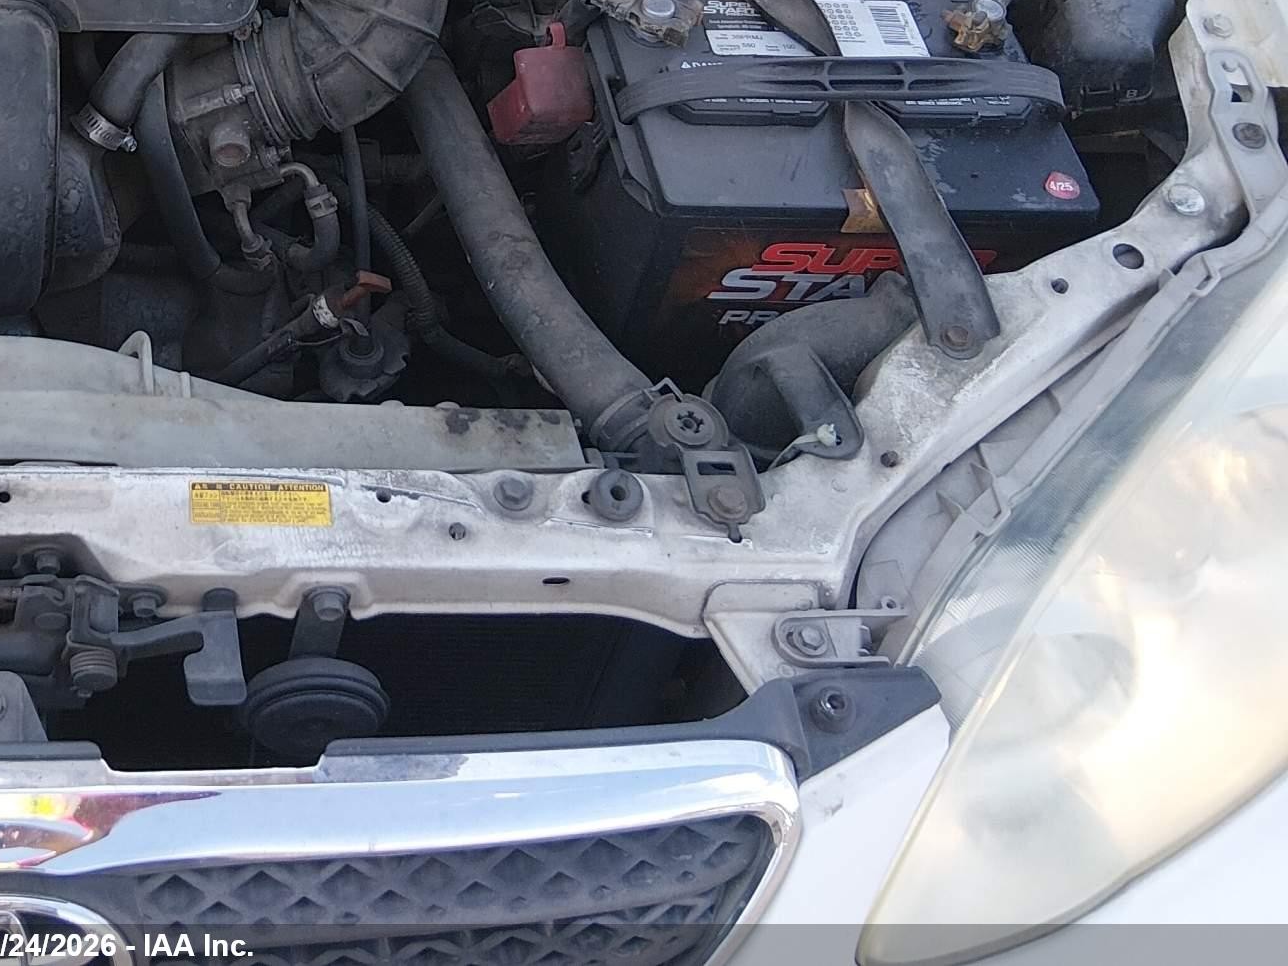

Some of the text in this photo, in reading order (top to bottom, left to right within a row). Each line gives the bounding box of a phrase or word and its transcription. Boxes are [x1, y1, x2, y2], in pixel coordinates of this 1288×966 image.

[752, 242, 997, 275] SUP
[706, 267, 870, 301] STA
[229, 483, 272, 491] CAUTION
[278, 483, 325, 492] ATTENTION
